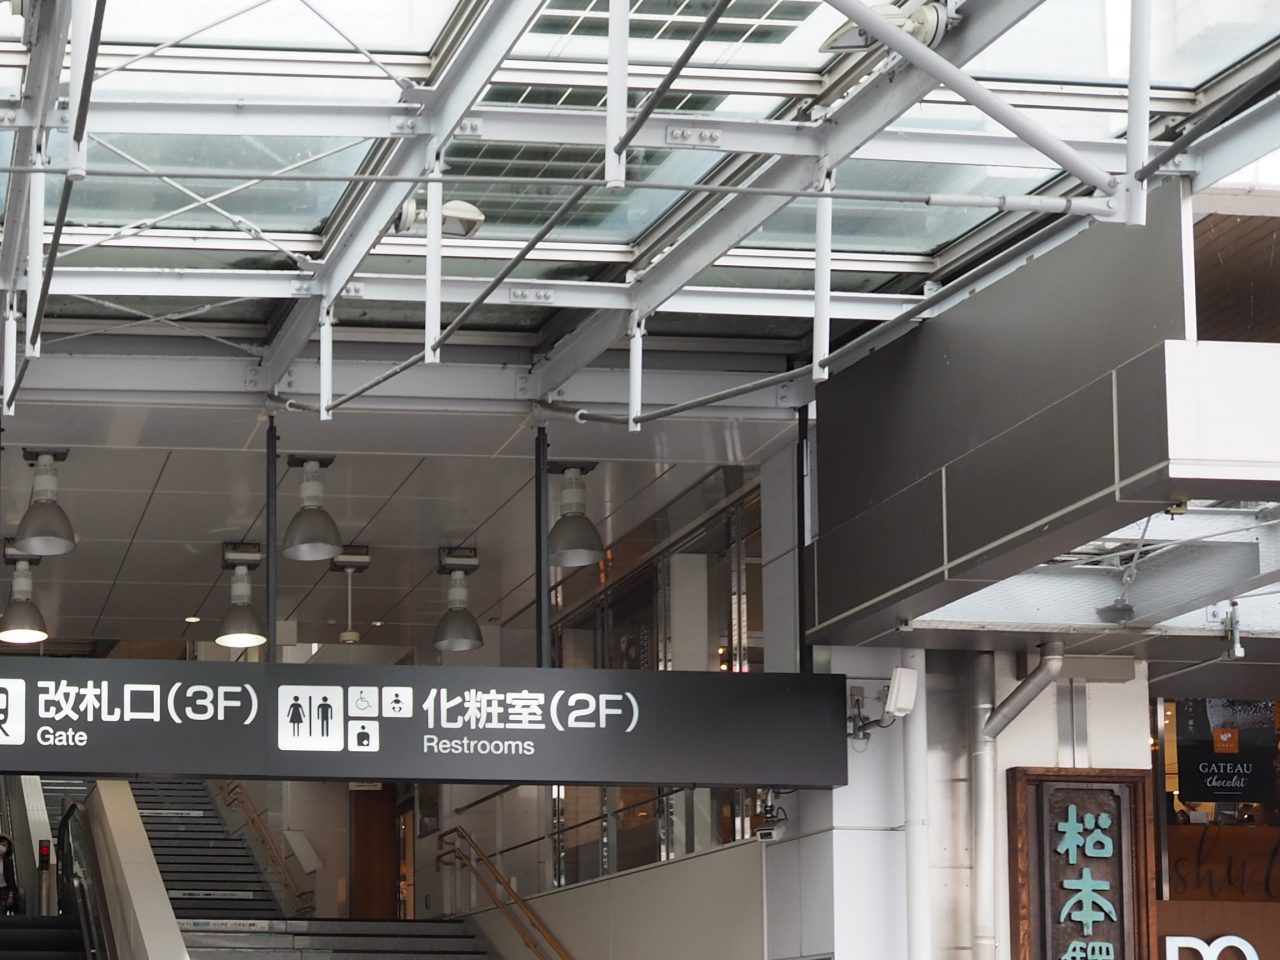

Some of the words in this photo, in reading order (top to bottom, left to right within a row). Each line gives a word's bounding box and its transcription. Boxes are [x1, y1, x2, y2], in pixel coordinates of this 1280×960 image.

[37, 680, 259, 725] 改札口(3F)
[423, 688, 640, 734] 化粧室(2F)
[37, 726, 88, 747] Gate
[424, 735, 535, 755] Restrooms
[1199, 763, 1252, 774] GATEAU
